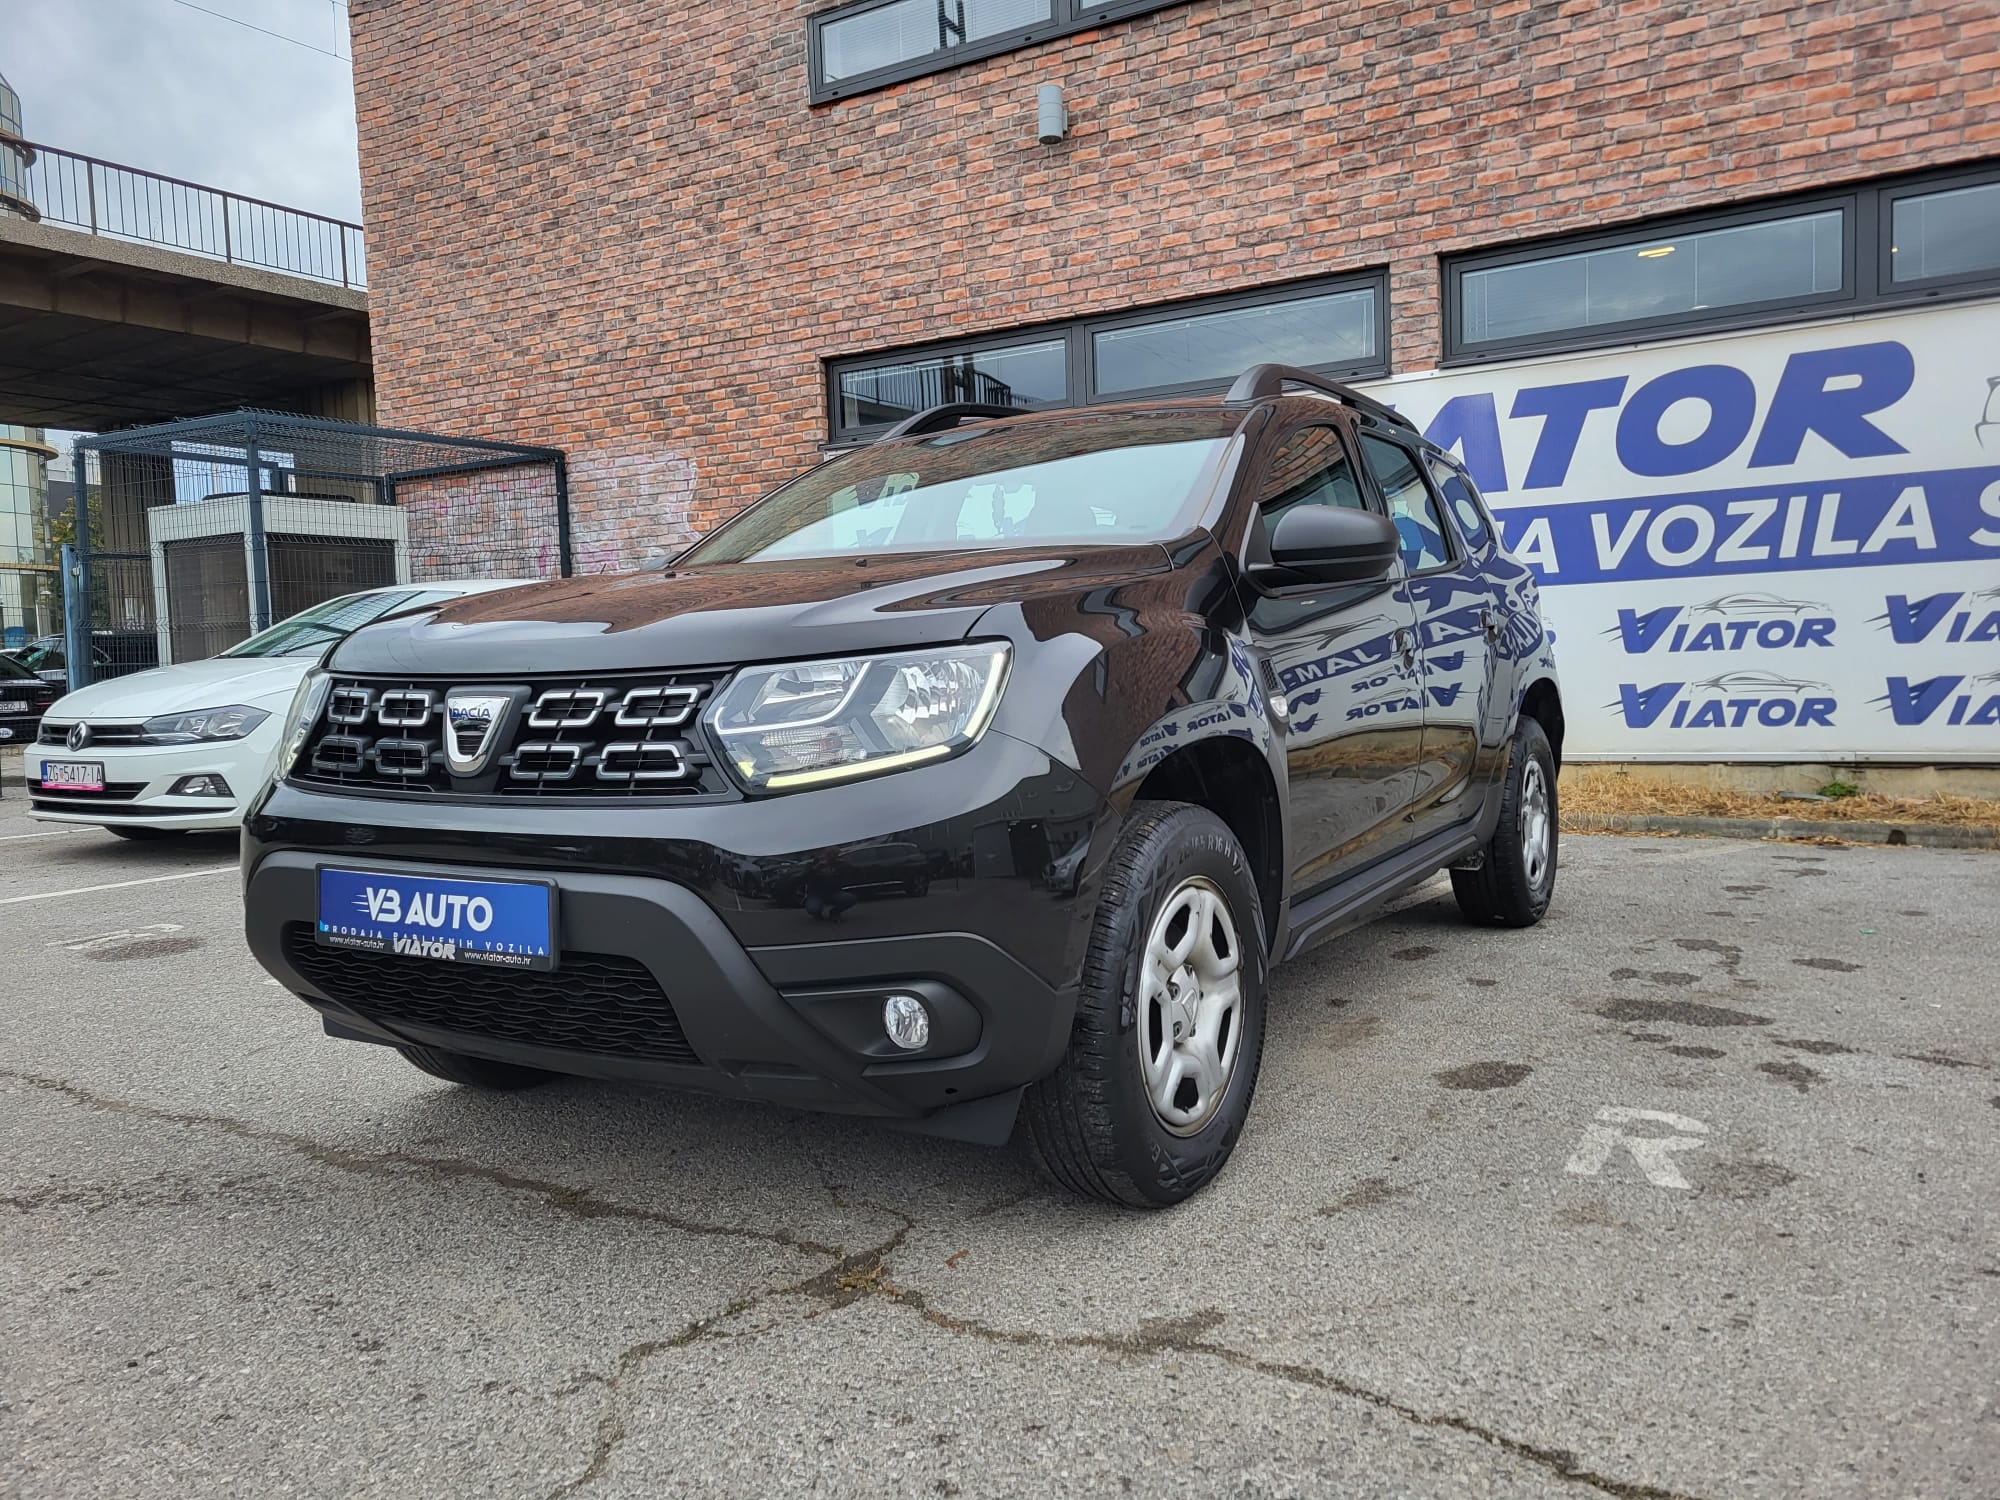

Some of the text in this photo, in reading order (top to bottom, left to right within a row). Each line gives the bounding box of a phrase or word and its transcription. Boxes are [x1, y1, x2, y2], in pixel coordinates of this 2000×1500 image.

[1590, 486, 1937, 571] VOZILA
[1615, 605, 1837, 654] VIATOR
[451, 707, 491, 719] DACIA
[1617, 682, 1838, 728] VIATOR
[48, 764, 59, 782] ZG
[404, 891, 494, 933] AUTO
[323, 924, 383, 940] PRODAJA
[485, 941, 544, 956] VOZILA
[393, 937, 456, 960] VIATOR
